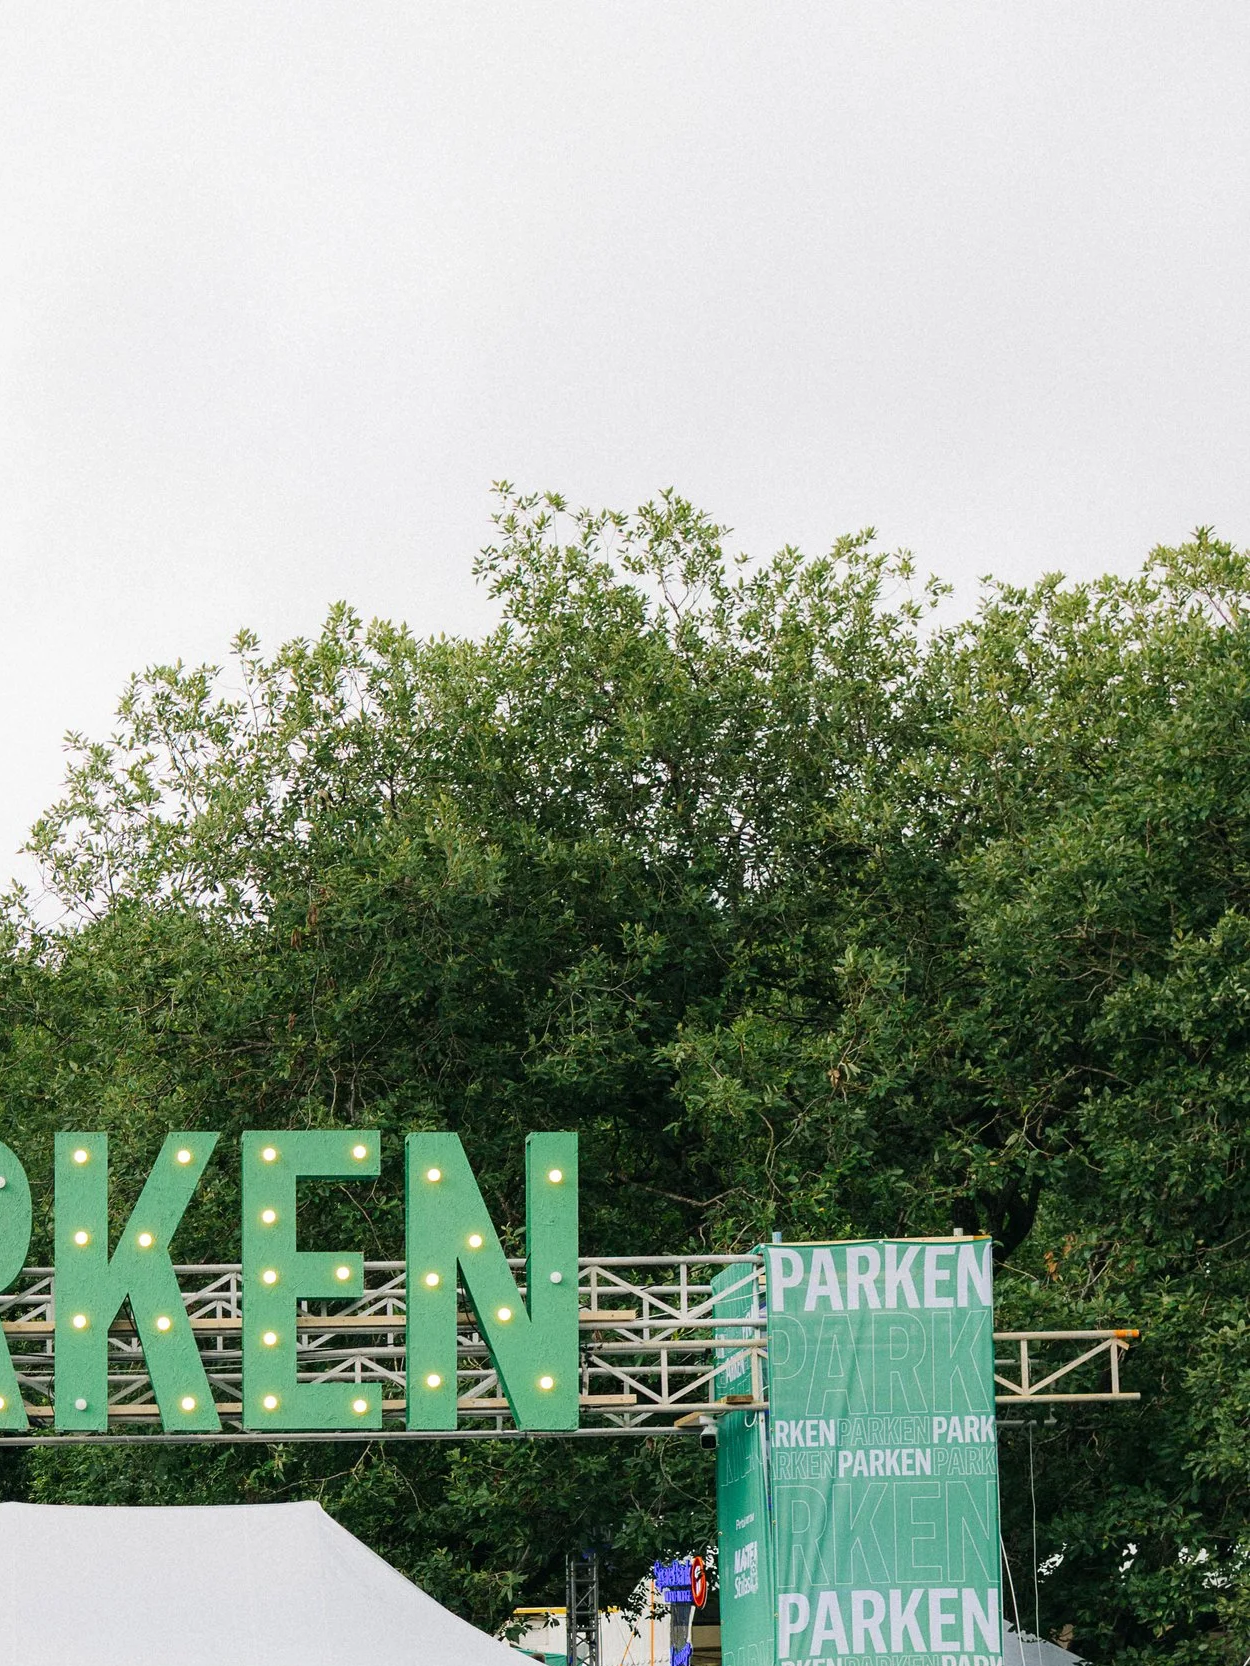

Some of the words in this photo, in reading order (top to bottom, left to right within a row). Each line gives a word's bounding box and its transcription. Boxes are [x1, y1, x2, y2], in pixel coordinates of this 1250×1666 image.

[768, 1242, 992, 1312] PARKEN
[772, 1419, 836, 1448] RKEN
[837, 1416, 930, 1446] PARKEN
[932, 1415, 996, 1444] PARK
[838, 1448, 931, 1478] PARKEN
[933, 1446, 997, 1476] PARK
[778, 1587, 1000, 1658] PARKEN
